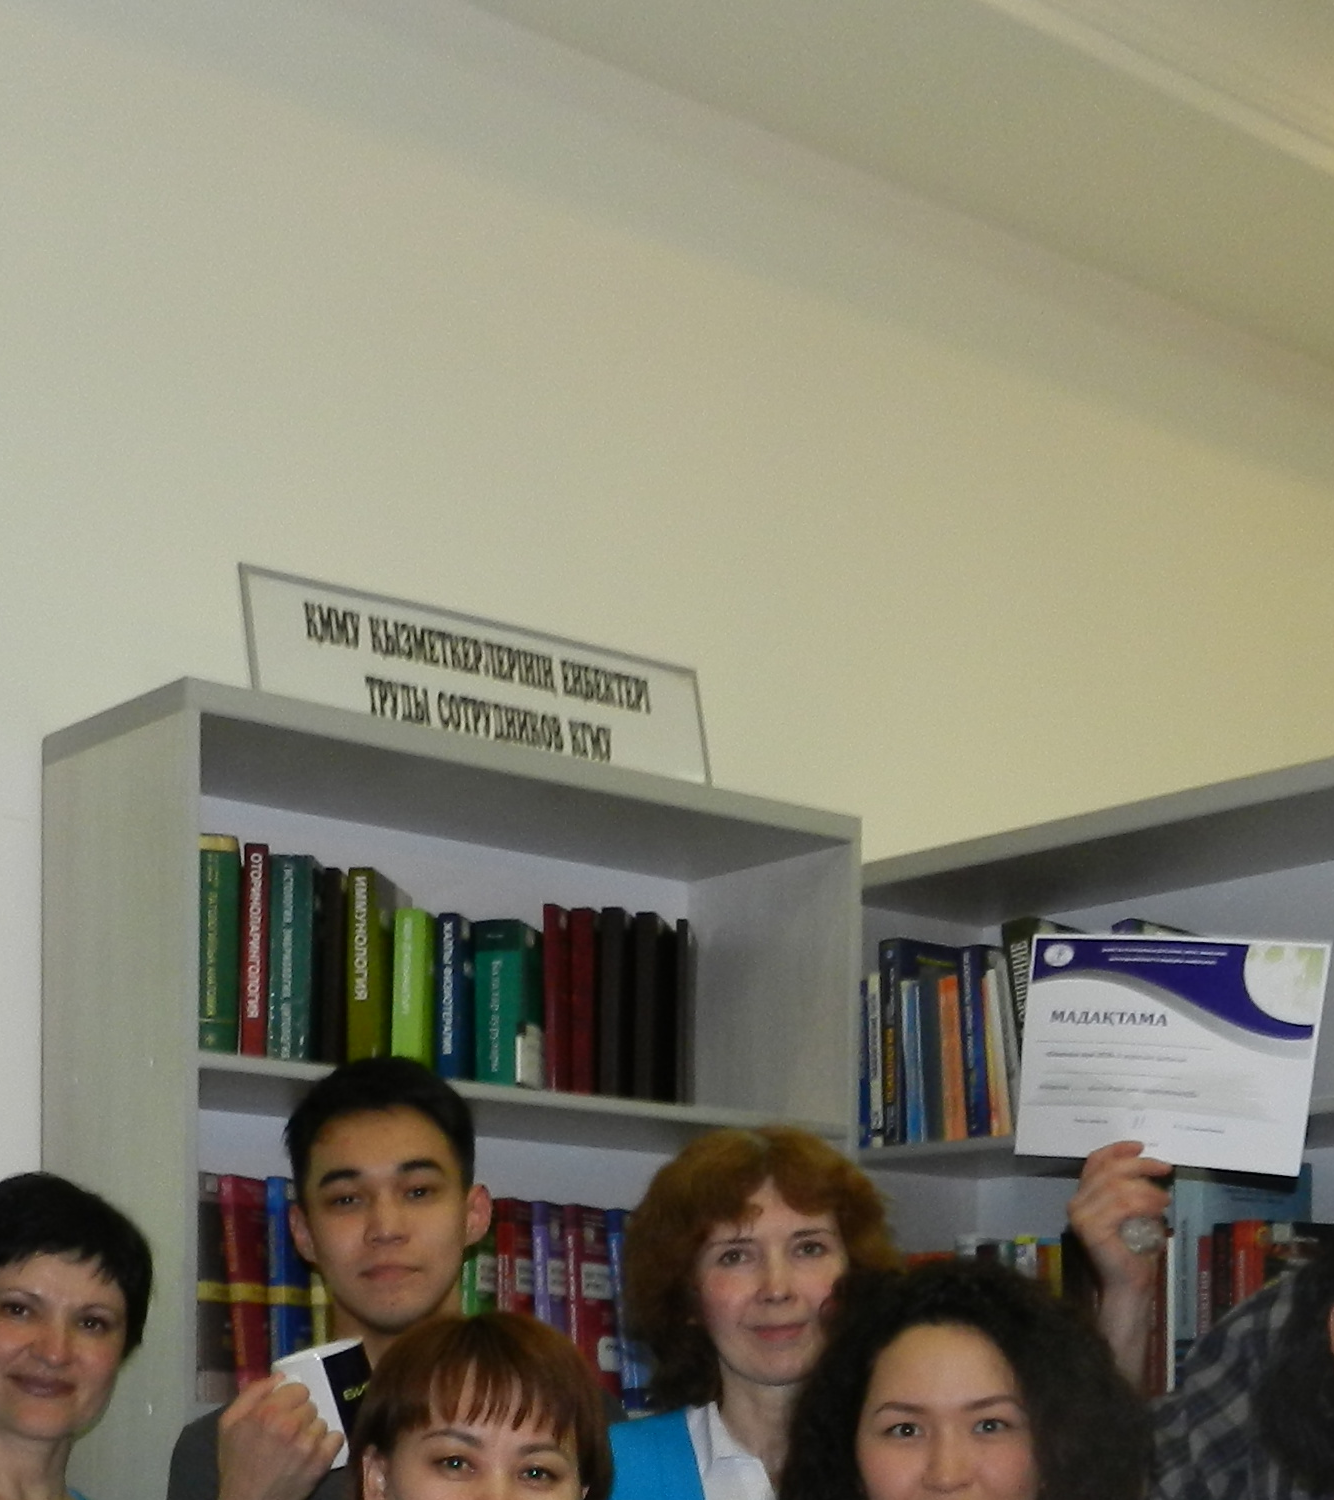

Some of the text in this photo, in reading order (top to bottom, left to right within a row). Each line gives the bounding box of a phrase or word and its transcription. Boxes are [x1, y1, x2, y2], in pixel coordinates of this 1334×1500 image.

[365, 675, 611, 763] ТРУДЫ СОТРУДНИКОВ КГМУ
[247, 852, 263, 1019] ОТОРИНОЛАРИНГОЛОГИЯ
[354, 875, 368, 1002] ИММУНОЛОГИЯ
